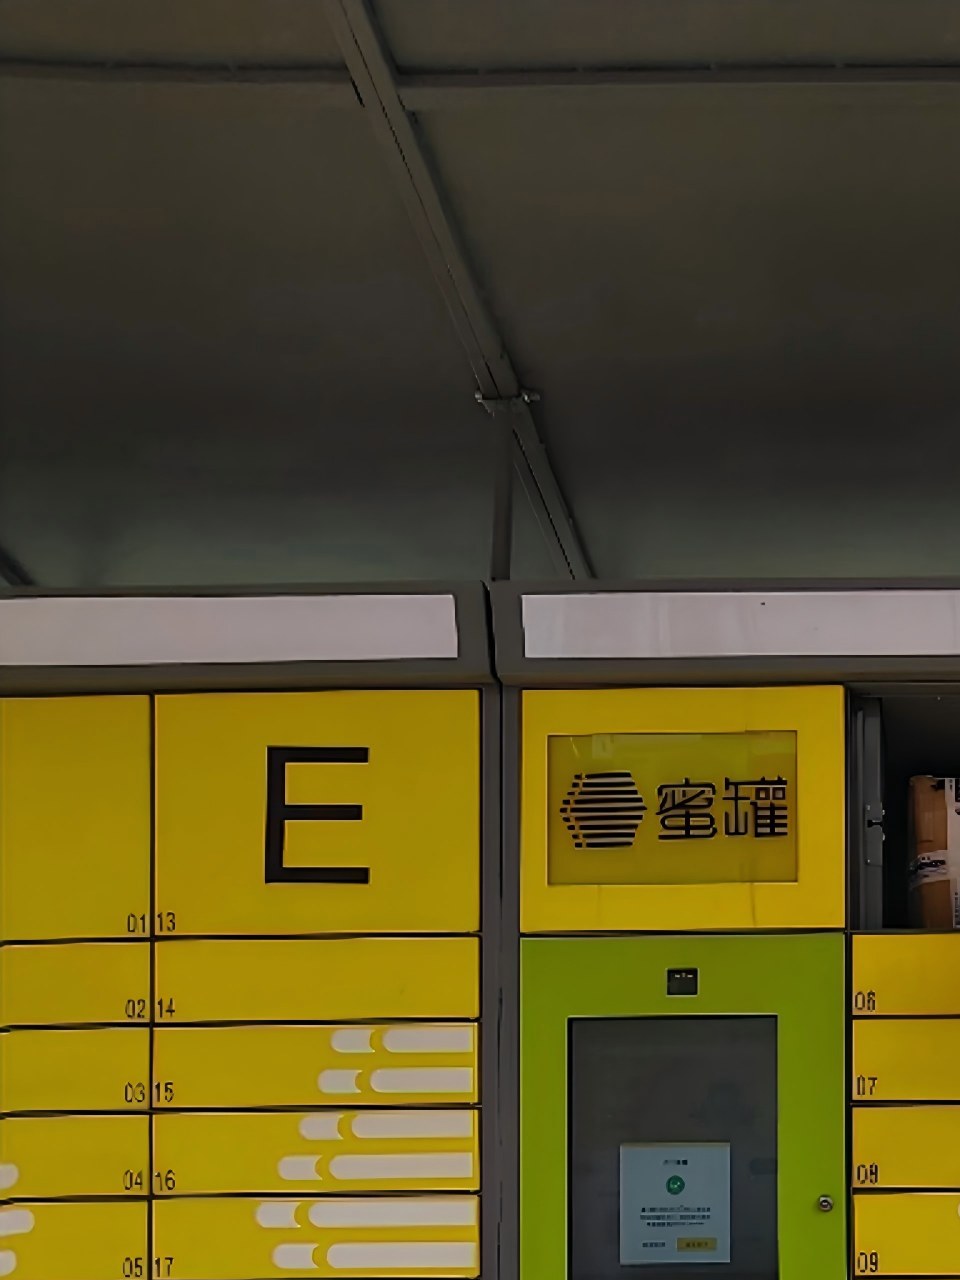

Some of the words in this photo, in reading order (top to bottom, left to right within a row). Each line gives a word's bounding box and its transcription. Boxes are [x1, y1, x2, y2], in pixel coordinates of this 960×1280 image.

[265, 746, 370, 884] E
[655, 776, 788, 839] 蜜罐
[127, 913, 146, 933] 01
[157, 912, 176, 932] 13
[125, 1000, 145, 1019] 02
[158, 998, 175, 1018] 14
[125, 1082, 145, 1103] 03
[155, 1082, 174, 1102] 15
[857, 1075, 878, 1096] 07
[123, 1169, 143, 1190] 04
[155, 1170, 176, 1190] 16
[122, 1257, 143, 1277] 05
[155, 1257, 174, 1276] 17
[857, 1251, 878, 1272] 09
